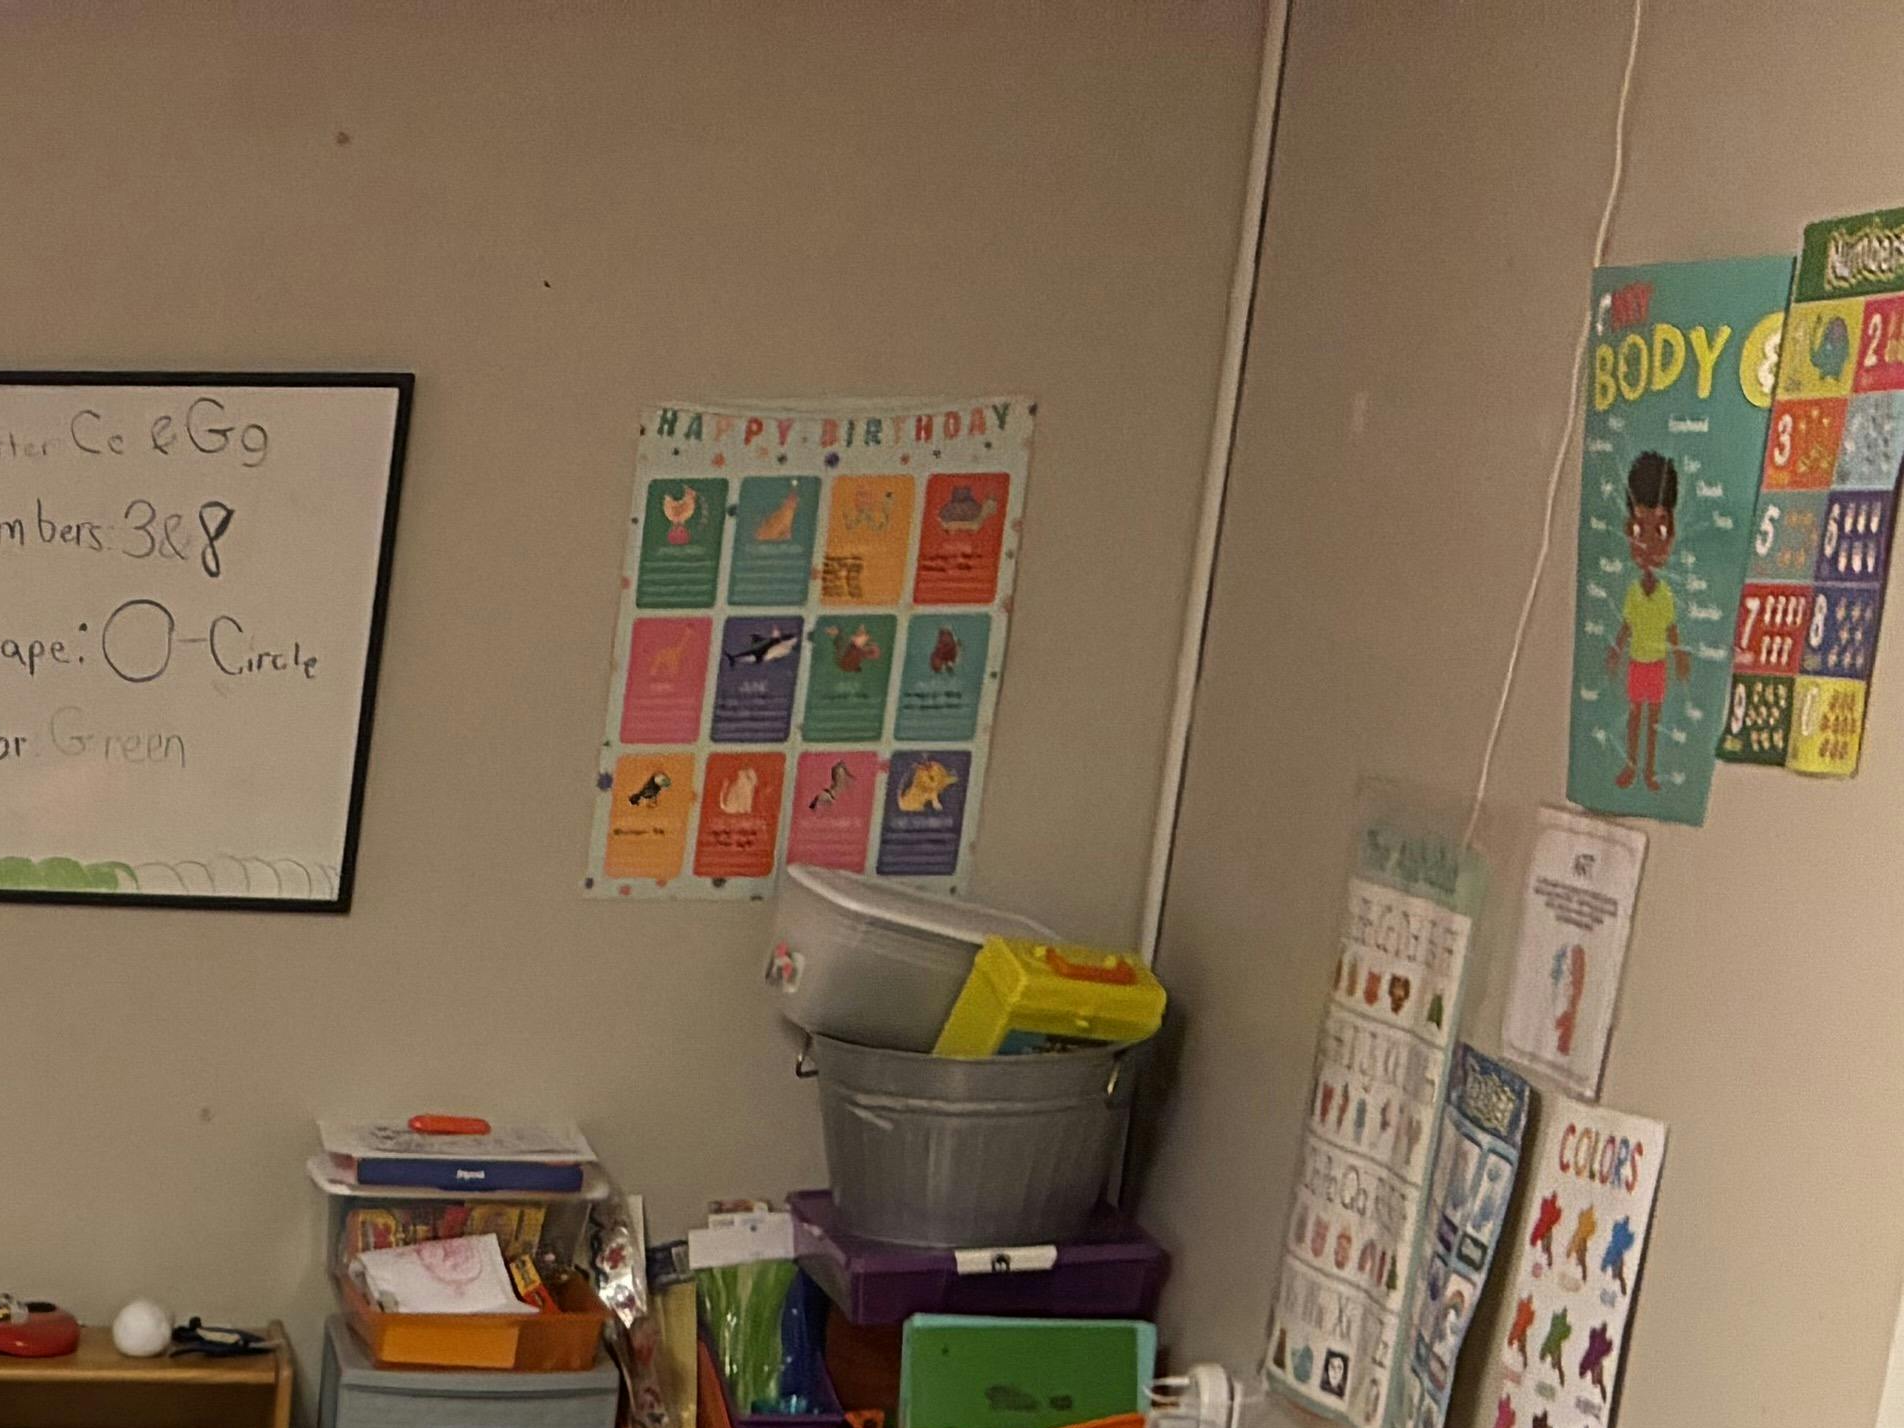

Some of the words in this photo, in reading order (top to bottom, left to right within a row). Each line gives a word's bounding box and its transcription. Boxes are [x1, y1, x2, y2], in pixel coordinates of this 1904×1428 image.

[1594, 323, 1733, 413] BODY
[656, 406, 794, 447] HAPPY
[820, 402, 1010, 449] BIRTHDAY
[50, 704, 187, 768] Green
[1557, 1122, 1644, 1194] COLORS
